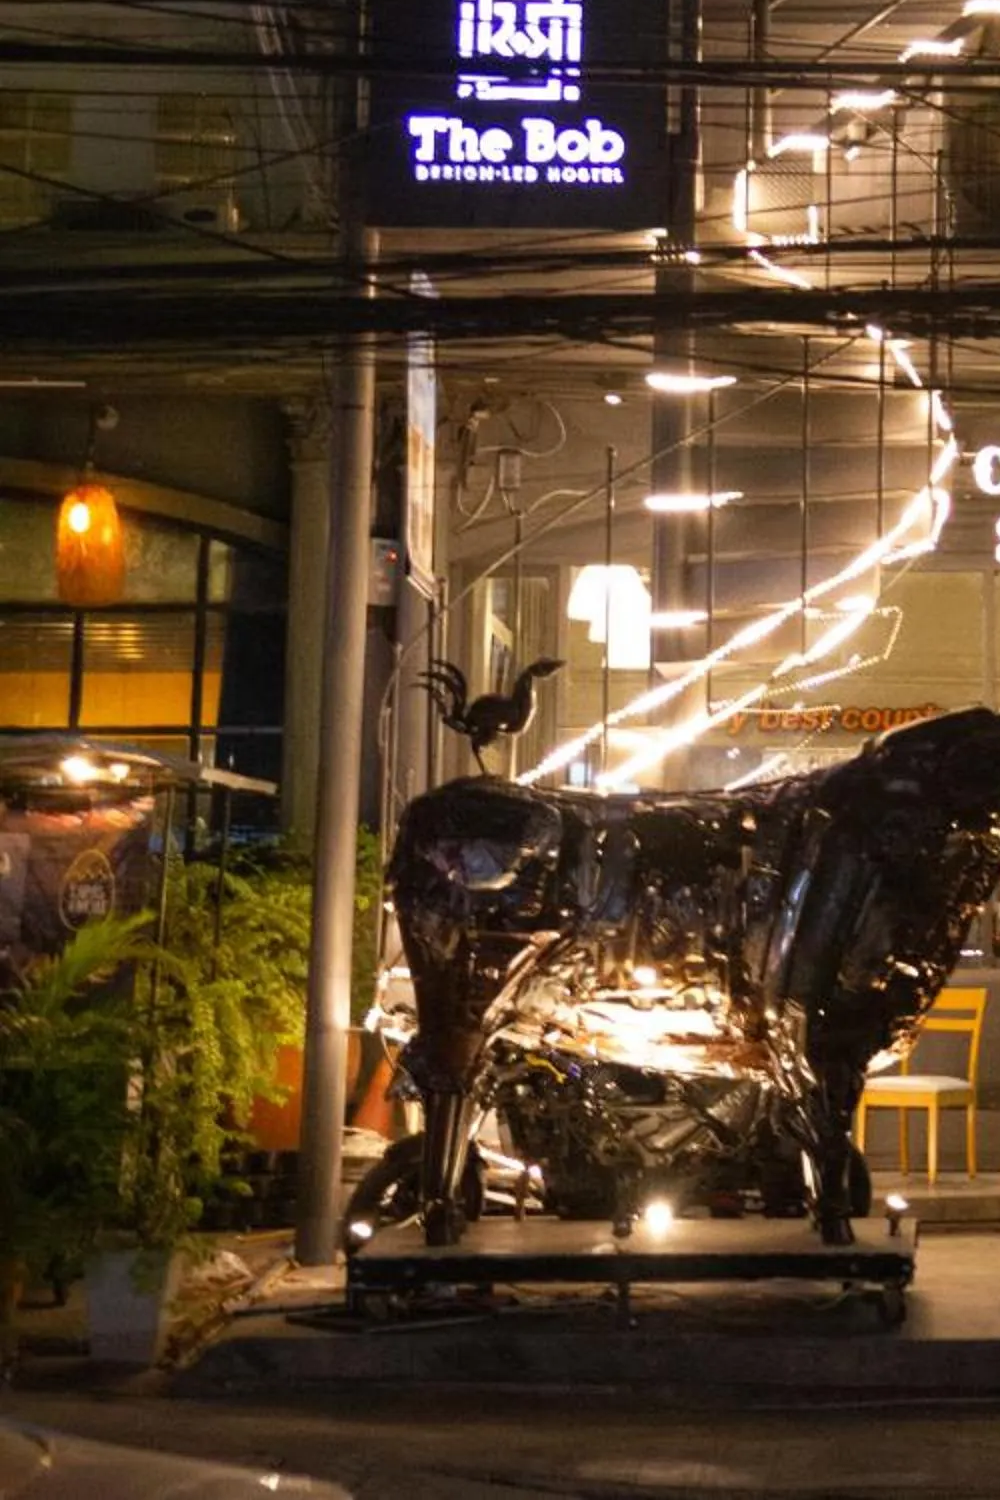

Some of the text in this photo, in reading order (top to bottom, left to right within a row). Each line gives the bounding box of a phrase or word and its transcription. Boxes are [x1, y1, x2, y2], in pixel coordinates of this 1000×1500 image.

[408, 116, 625, 164] The Bob
[546, 166, 625, 184] HOSTEL
[758, 699, 834, 732] best
